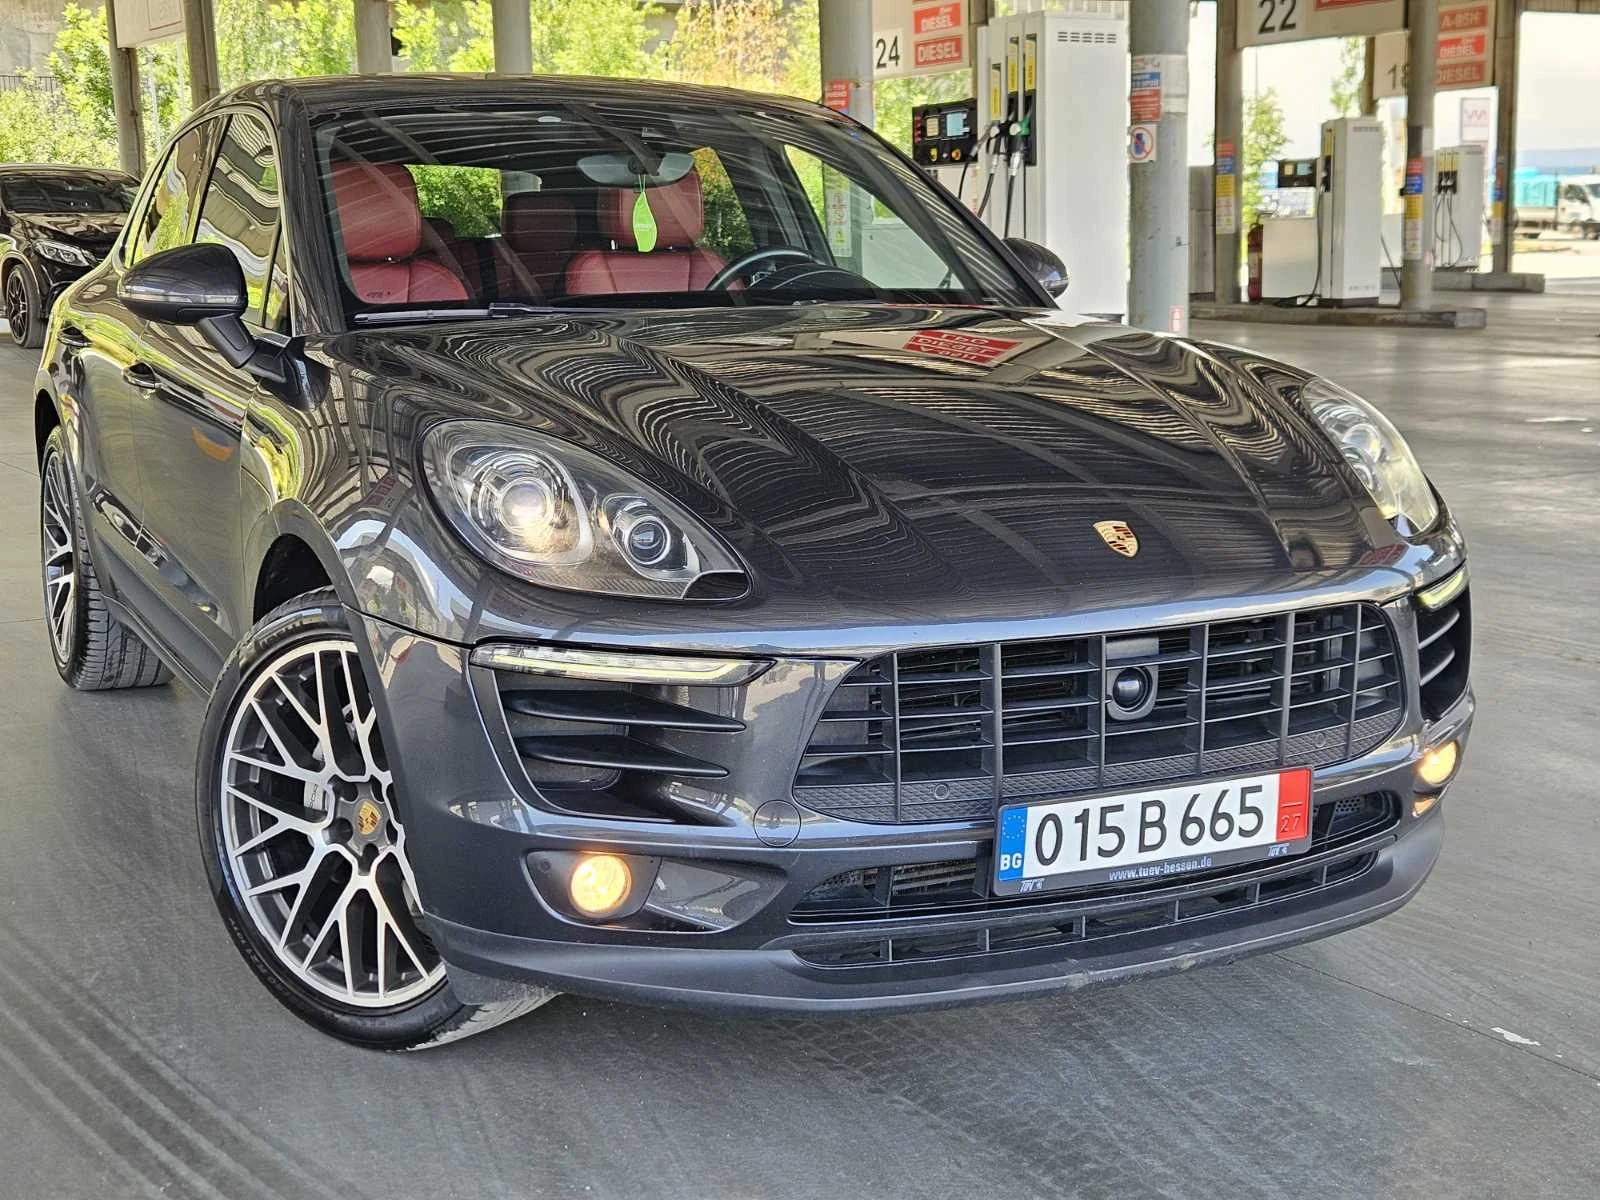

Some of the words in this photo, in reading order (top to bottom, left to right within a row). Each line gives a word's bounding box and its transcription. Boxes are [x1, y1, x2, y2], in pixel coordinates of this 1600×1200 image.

[1258, 0, 1297, 34] 22
[876, 35, 900, 69] 24
[917, 41, 960, 63] DIESEL
[1280, 814, 1302, 833] 27
[999, 852, 1023, 871] BG
[1109, 856, 1213, 881] www.tuev-hessen.de
